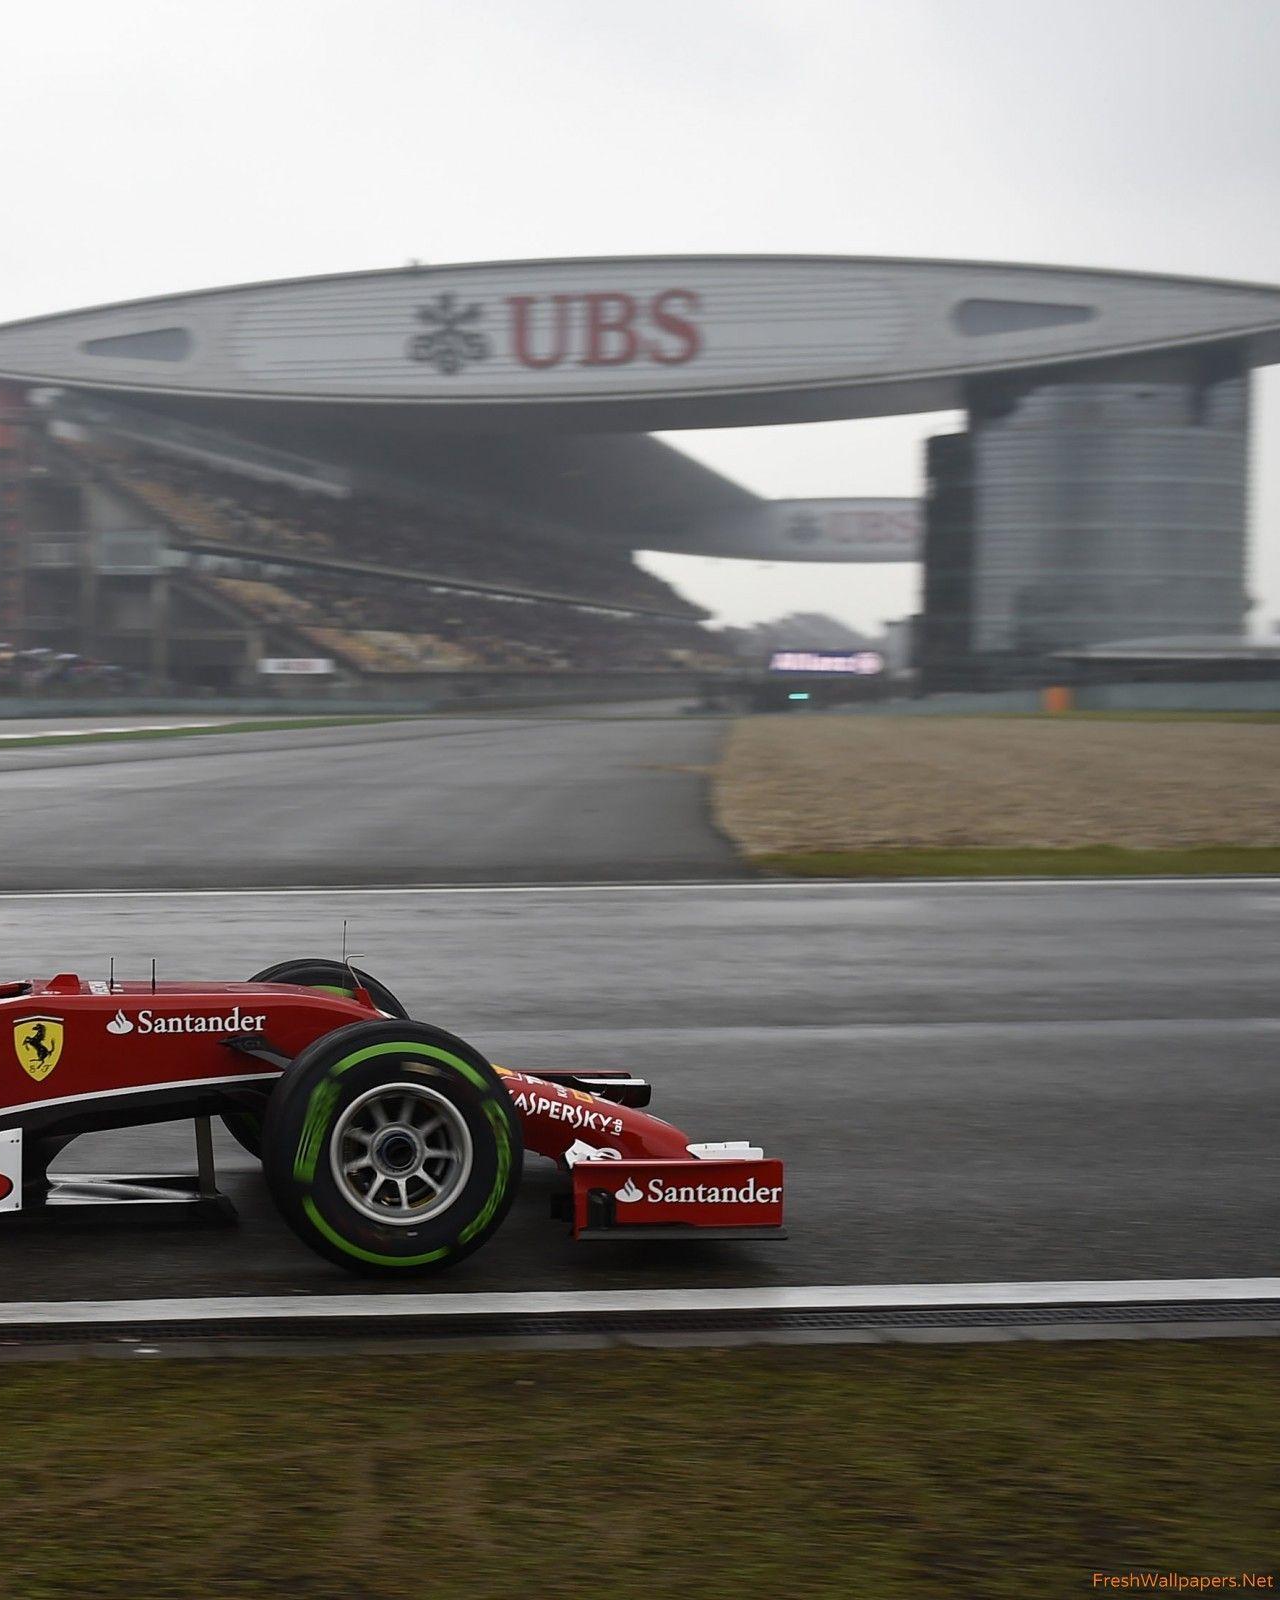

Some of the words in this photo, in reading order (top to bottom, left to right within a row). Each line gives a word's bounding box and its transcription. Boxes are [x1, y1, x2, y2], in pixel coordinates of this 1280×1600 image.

[505, 288, 702, 369] UBS
[137, 1006, 266, 1034] Santander
[508, 1089, 613, 1133] ASPERSKY
[648, 1178, 783, 1204] Santander
